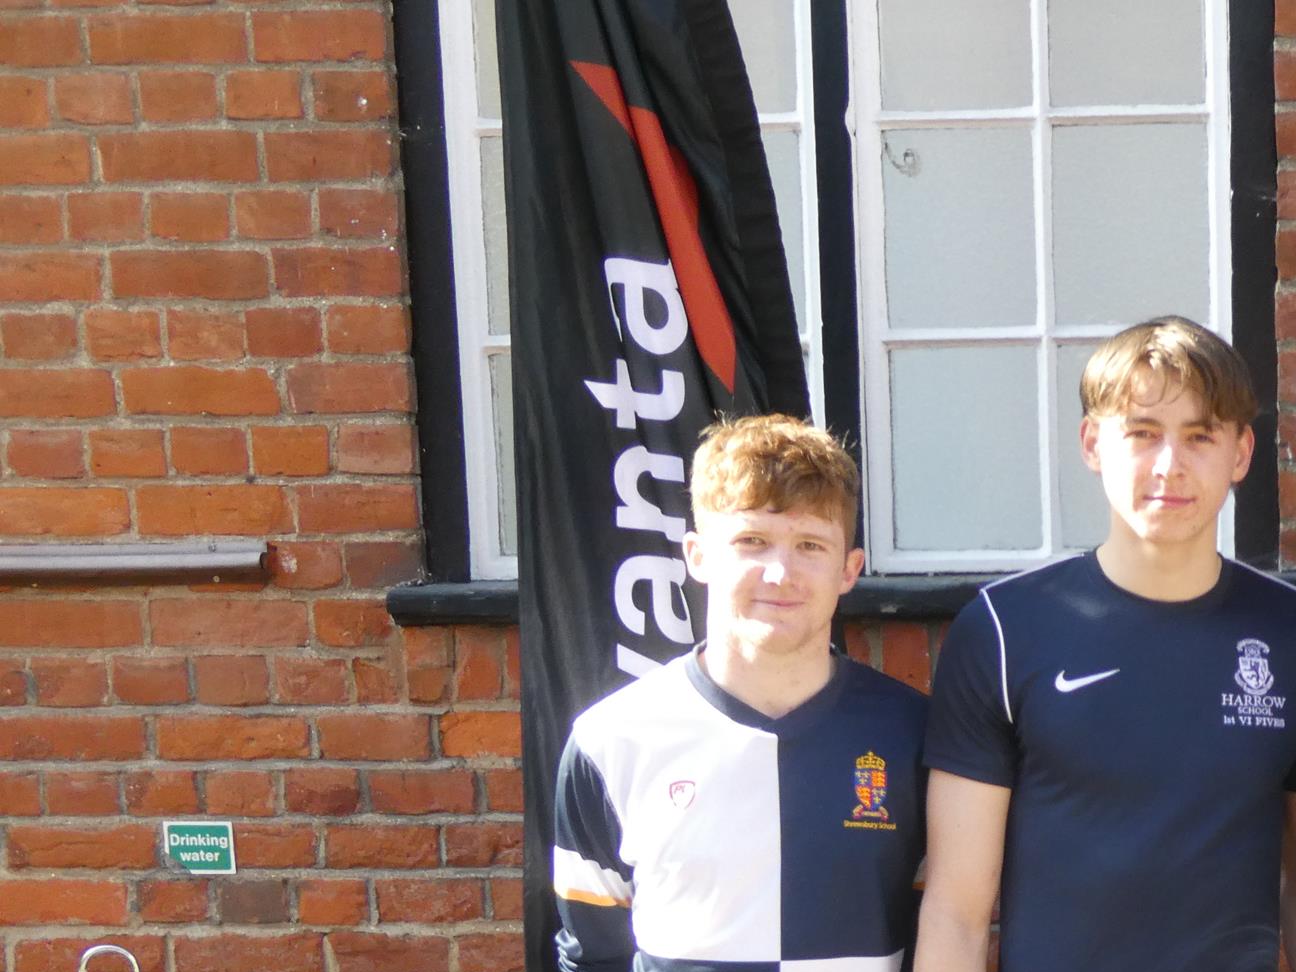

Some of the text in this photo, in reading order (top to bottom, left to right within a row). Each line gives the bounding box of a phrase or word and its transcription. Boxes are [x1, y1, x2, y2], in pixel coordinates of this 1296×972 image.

[1221, 693, 1286, 709] HARROW
[1238, 706, 1273, 716] SCHOOL
[1240, 716, 1252, 726] VI
[169, 833, 229, 849] Drinking
[180, 849, 220, 862] water
